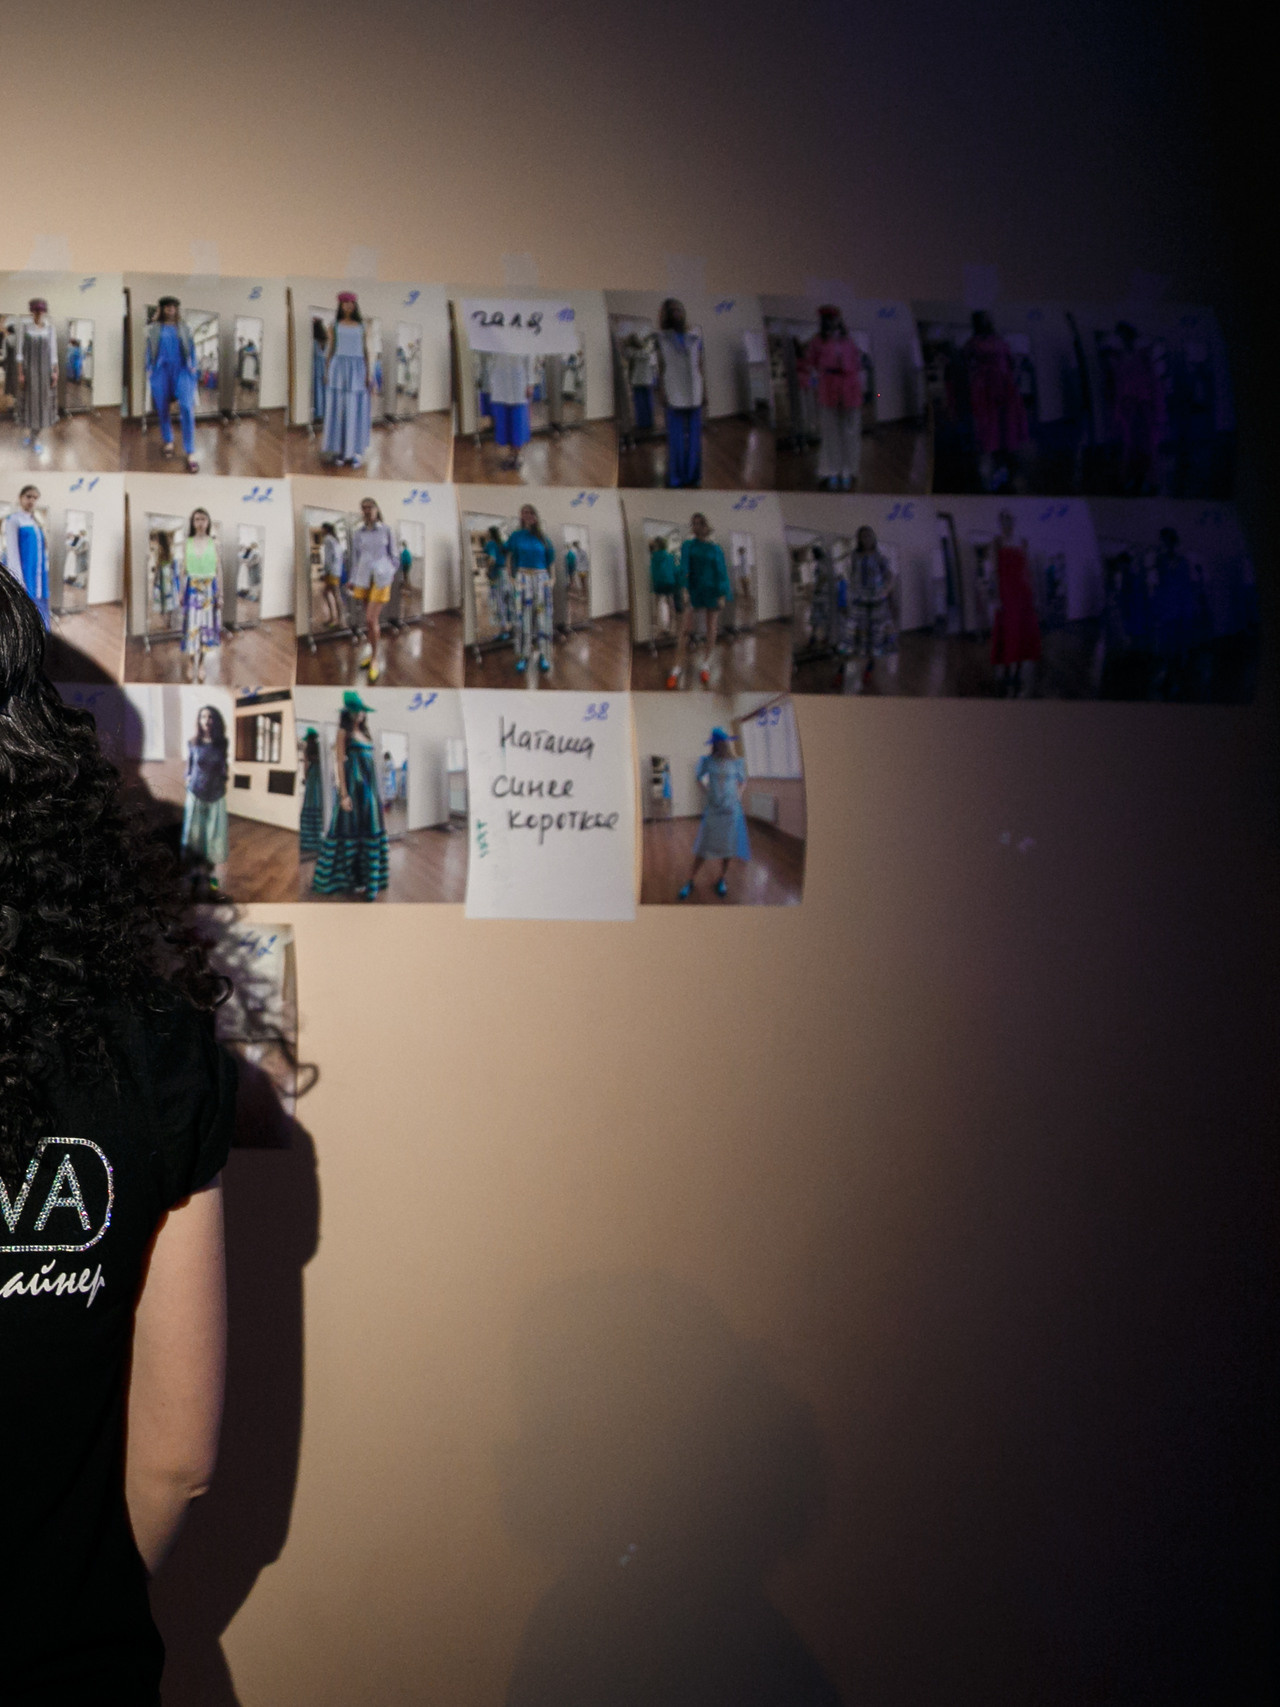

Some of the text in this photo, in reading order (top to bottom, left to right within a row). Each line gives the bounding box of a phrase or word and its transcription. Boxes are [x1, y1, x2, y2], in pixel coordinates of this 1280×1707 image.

[78, 276, 97, 292] 7
[402, 289, 421, 307] 9
[69, 477, 100, 492] 21
[242, 486, 274, 502] 22
[407, 692, 438, 712] 37
[584, 701, 610, 720] 38
[498, 715, 596, 761] Наташа
